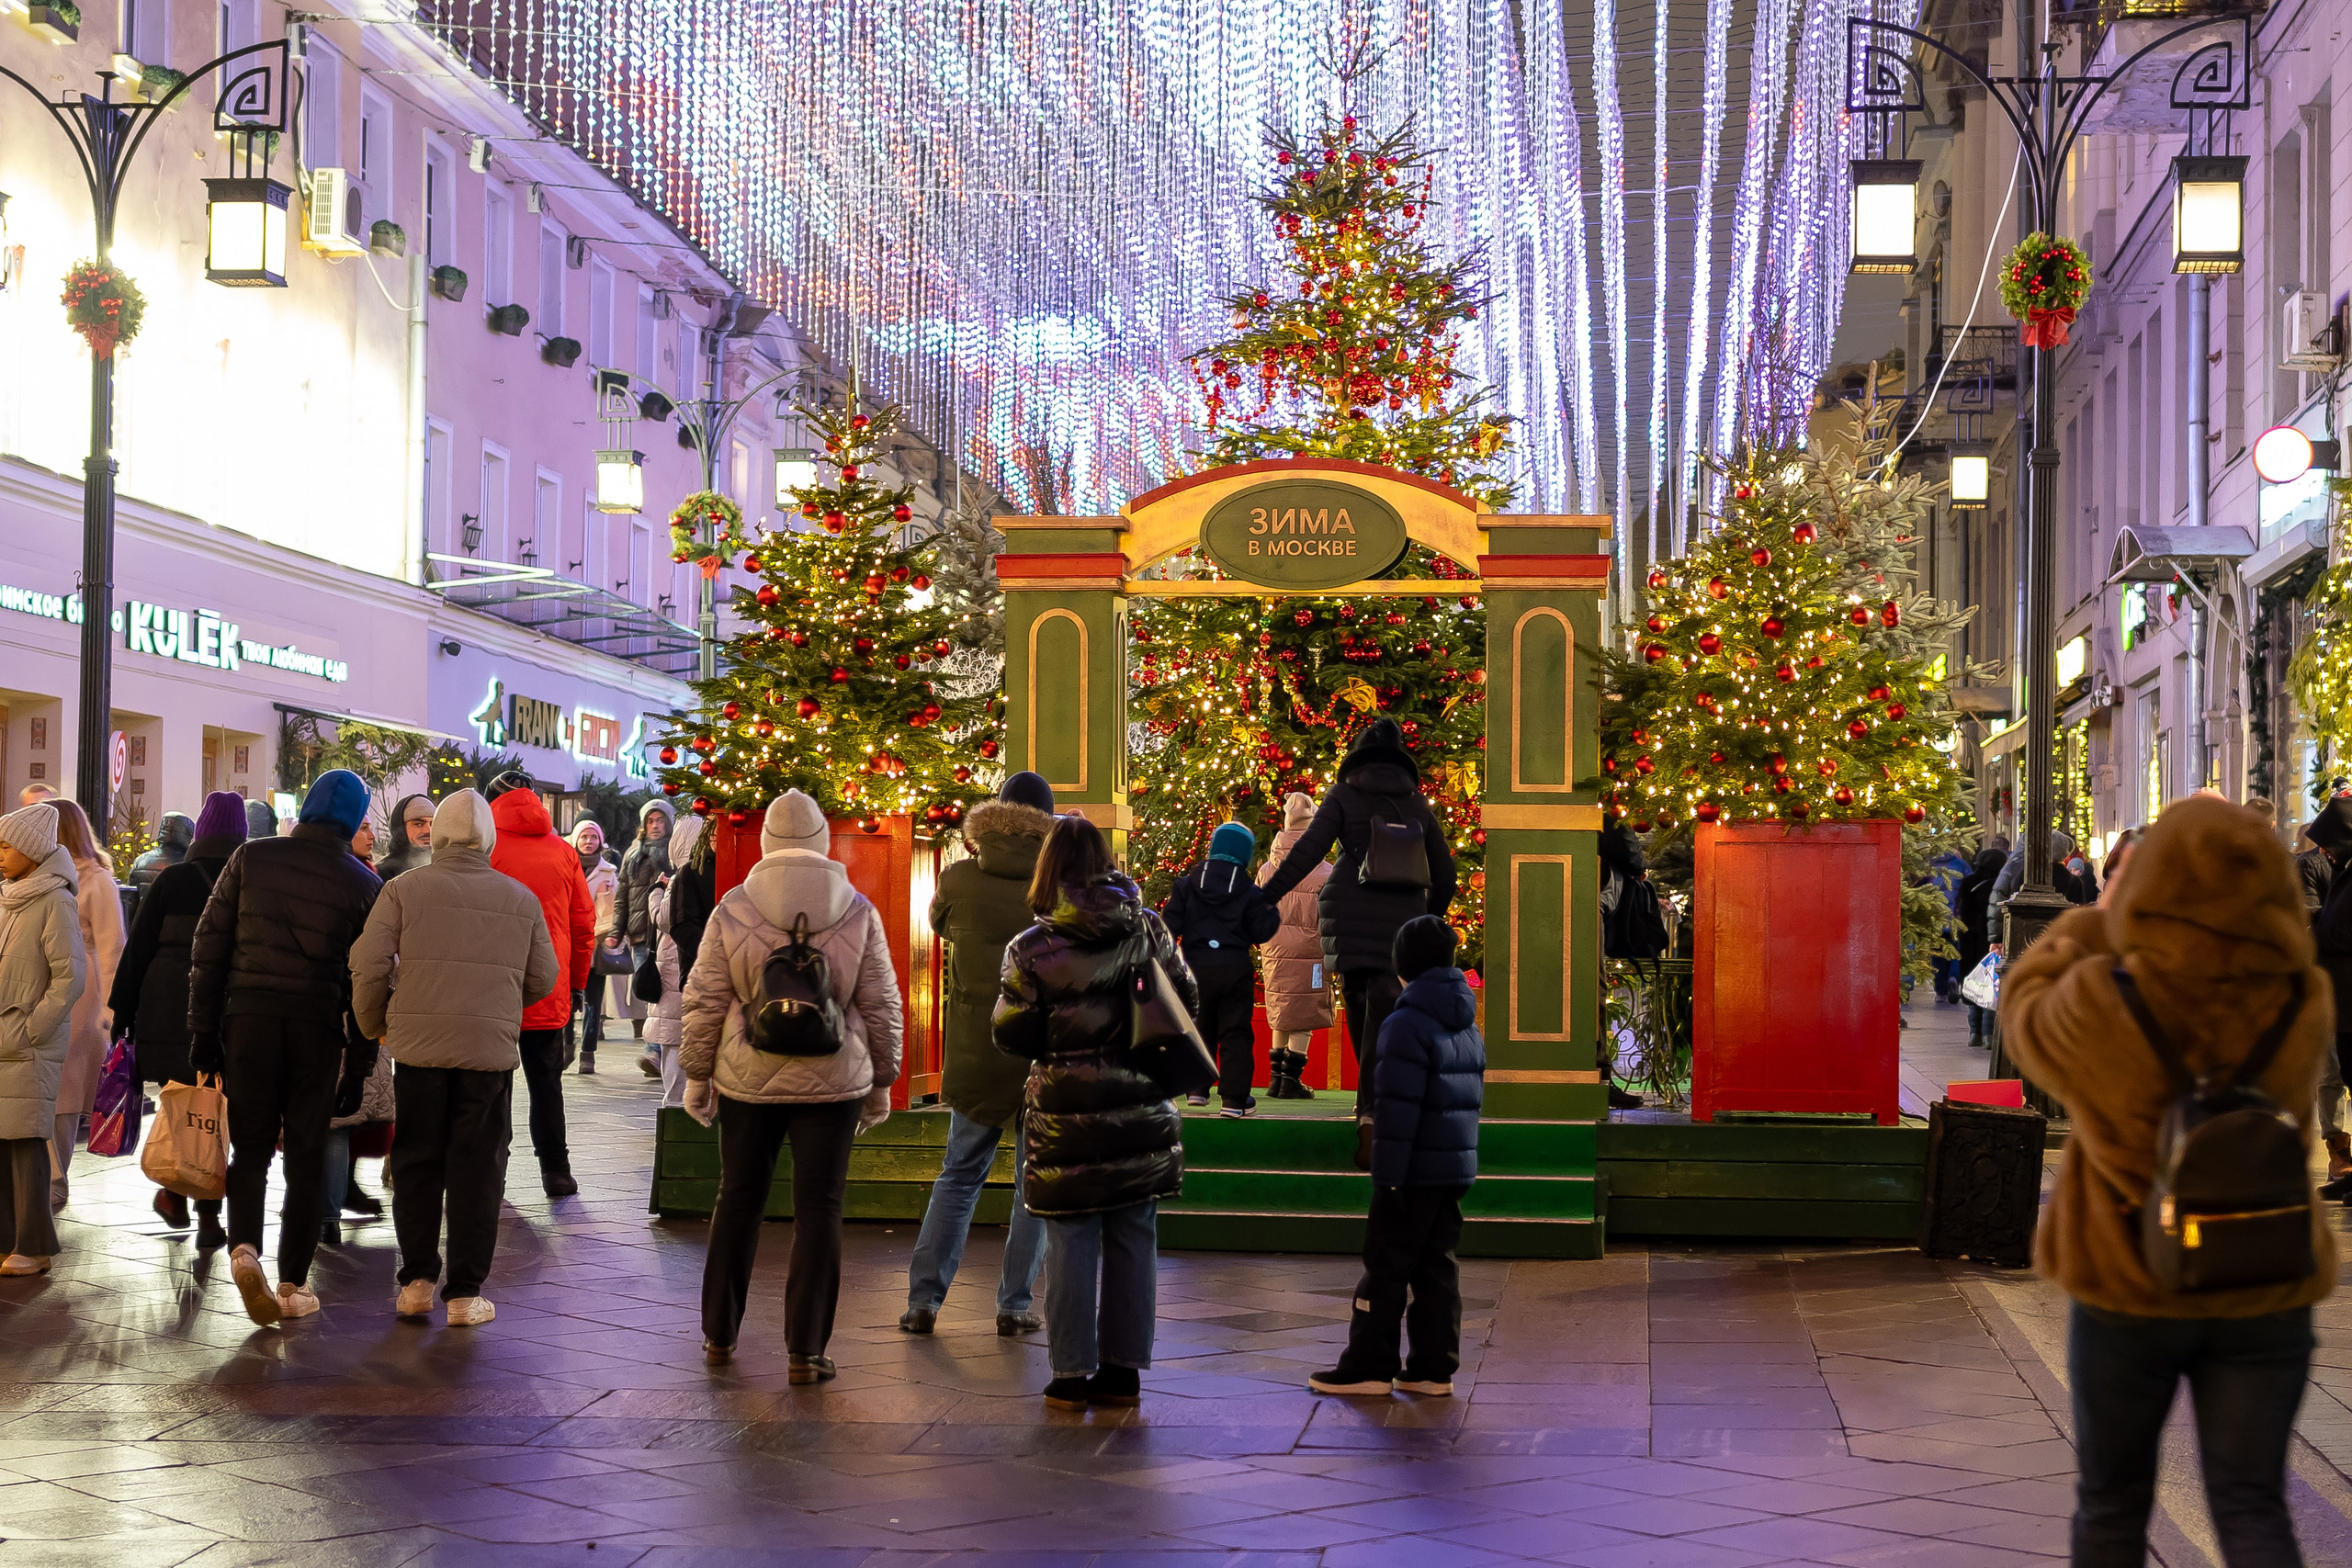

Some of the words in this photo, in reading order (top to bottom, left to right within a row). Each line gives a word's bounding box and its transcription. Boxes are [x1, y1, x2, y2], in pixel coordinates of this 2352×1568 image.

[1249, 507, 1357, 535] ЗИМА
[1248, 539, 1261, 557] В
[1267, 539, 1358, 557] МОСКВЕ
[0, 584, 63, 620] имское
[241, 639, 271, 665] твоя
[272, 645, 324, 677] любимая
[325, 659, 348, 682] еда
[513, 694, 561, 750] FRANK
